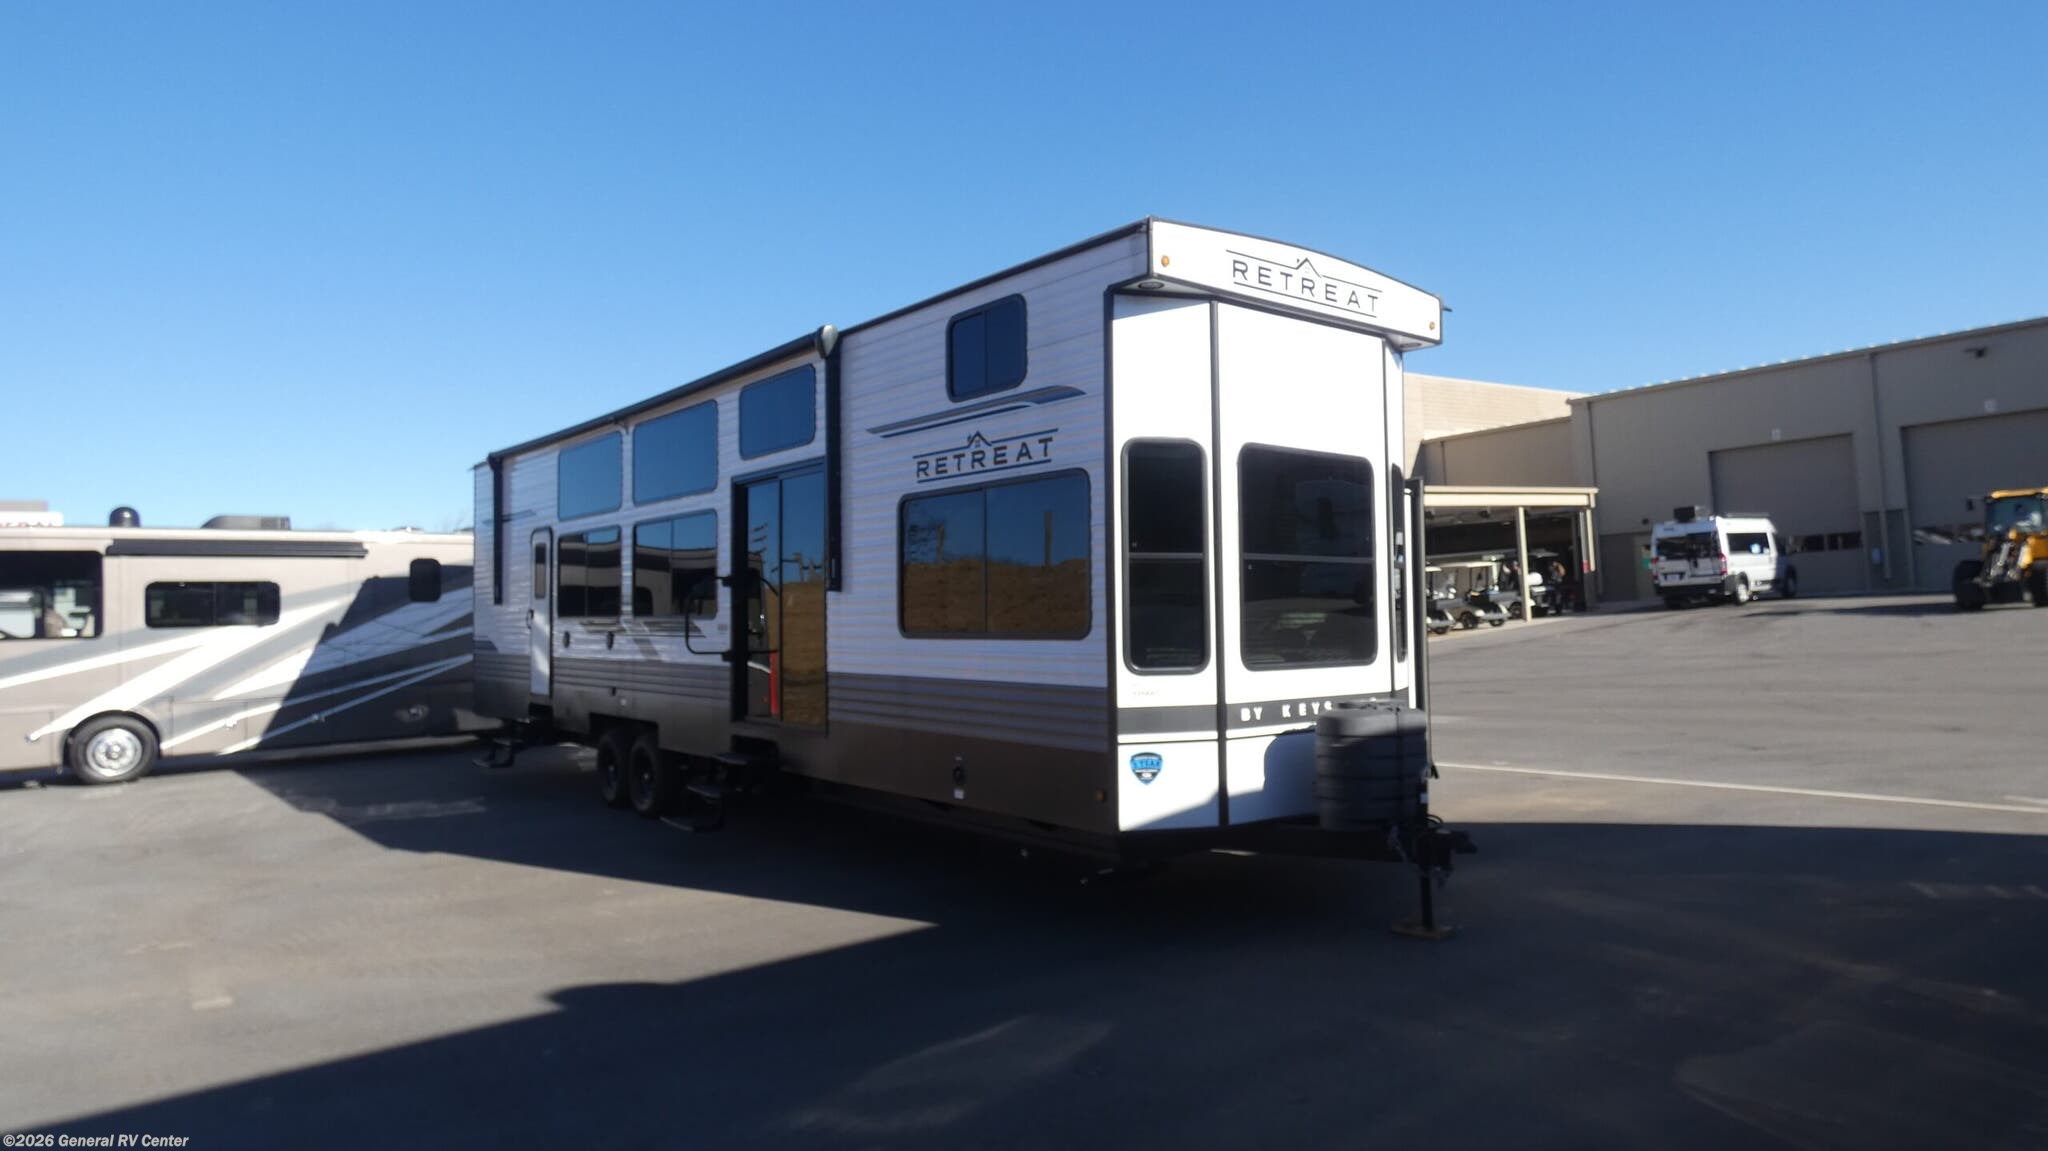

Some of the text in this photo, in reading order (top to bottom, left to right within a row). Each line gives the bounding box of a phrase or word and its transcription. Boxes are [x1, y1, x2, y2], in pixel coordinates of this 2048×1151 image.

[1232, 259, 1379, 313] RETREAT
[916, 437, 1053, 478] RETREAT
[1241, 707, 1262, 721] BY
